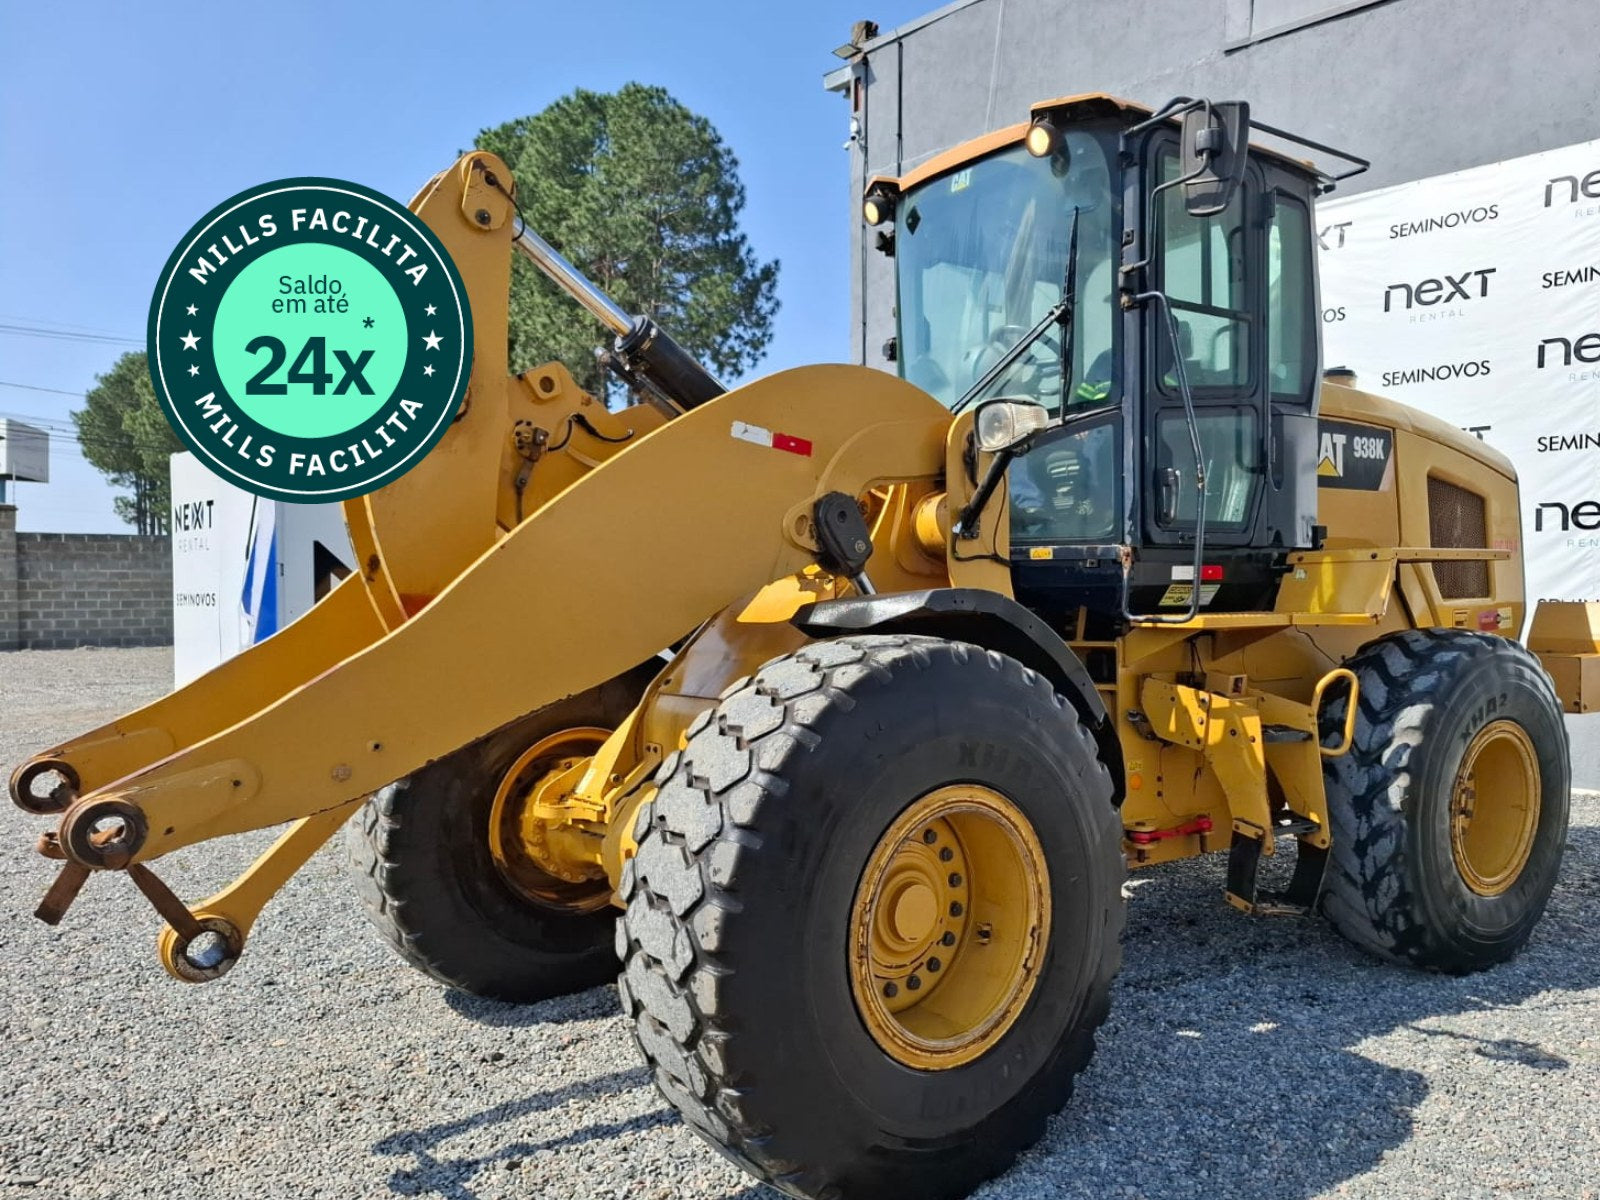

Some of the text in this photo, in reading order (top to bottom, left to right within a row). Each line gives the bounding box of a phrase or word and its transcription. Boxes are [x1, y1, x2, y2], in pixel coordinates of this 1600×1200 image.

[951, 169, 972, 193] CAT
[1389, 204, 1499, 239] SEMINOVOS
[1542, 266, 1600, 289] SEMIN
[1321, 306, 1346, 323] OS
[1409, 308, 1466, 324] RENTAL
[1382, 360, 1491, 387] SEMINOVOS
[1537, 432, 1600, 452] SEMIN
[1317, 432, 1385, 477] AT 938K
[175, 500, 214, 532] NEXT
[176, 593, 216, 607] SEMINOVOS
